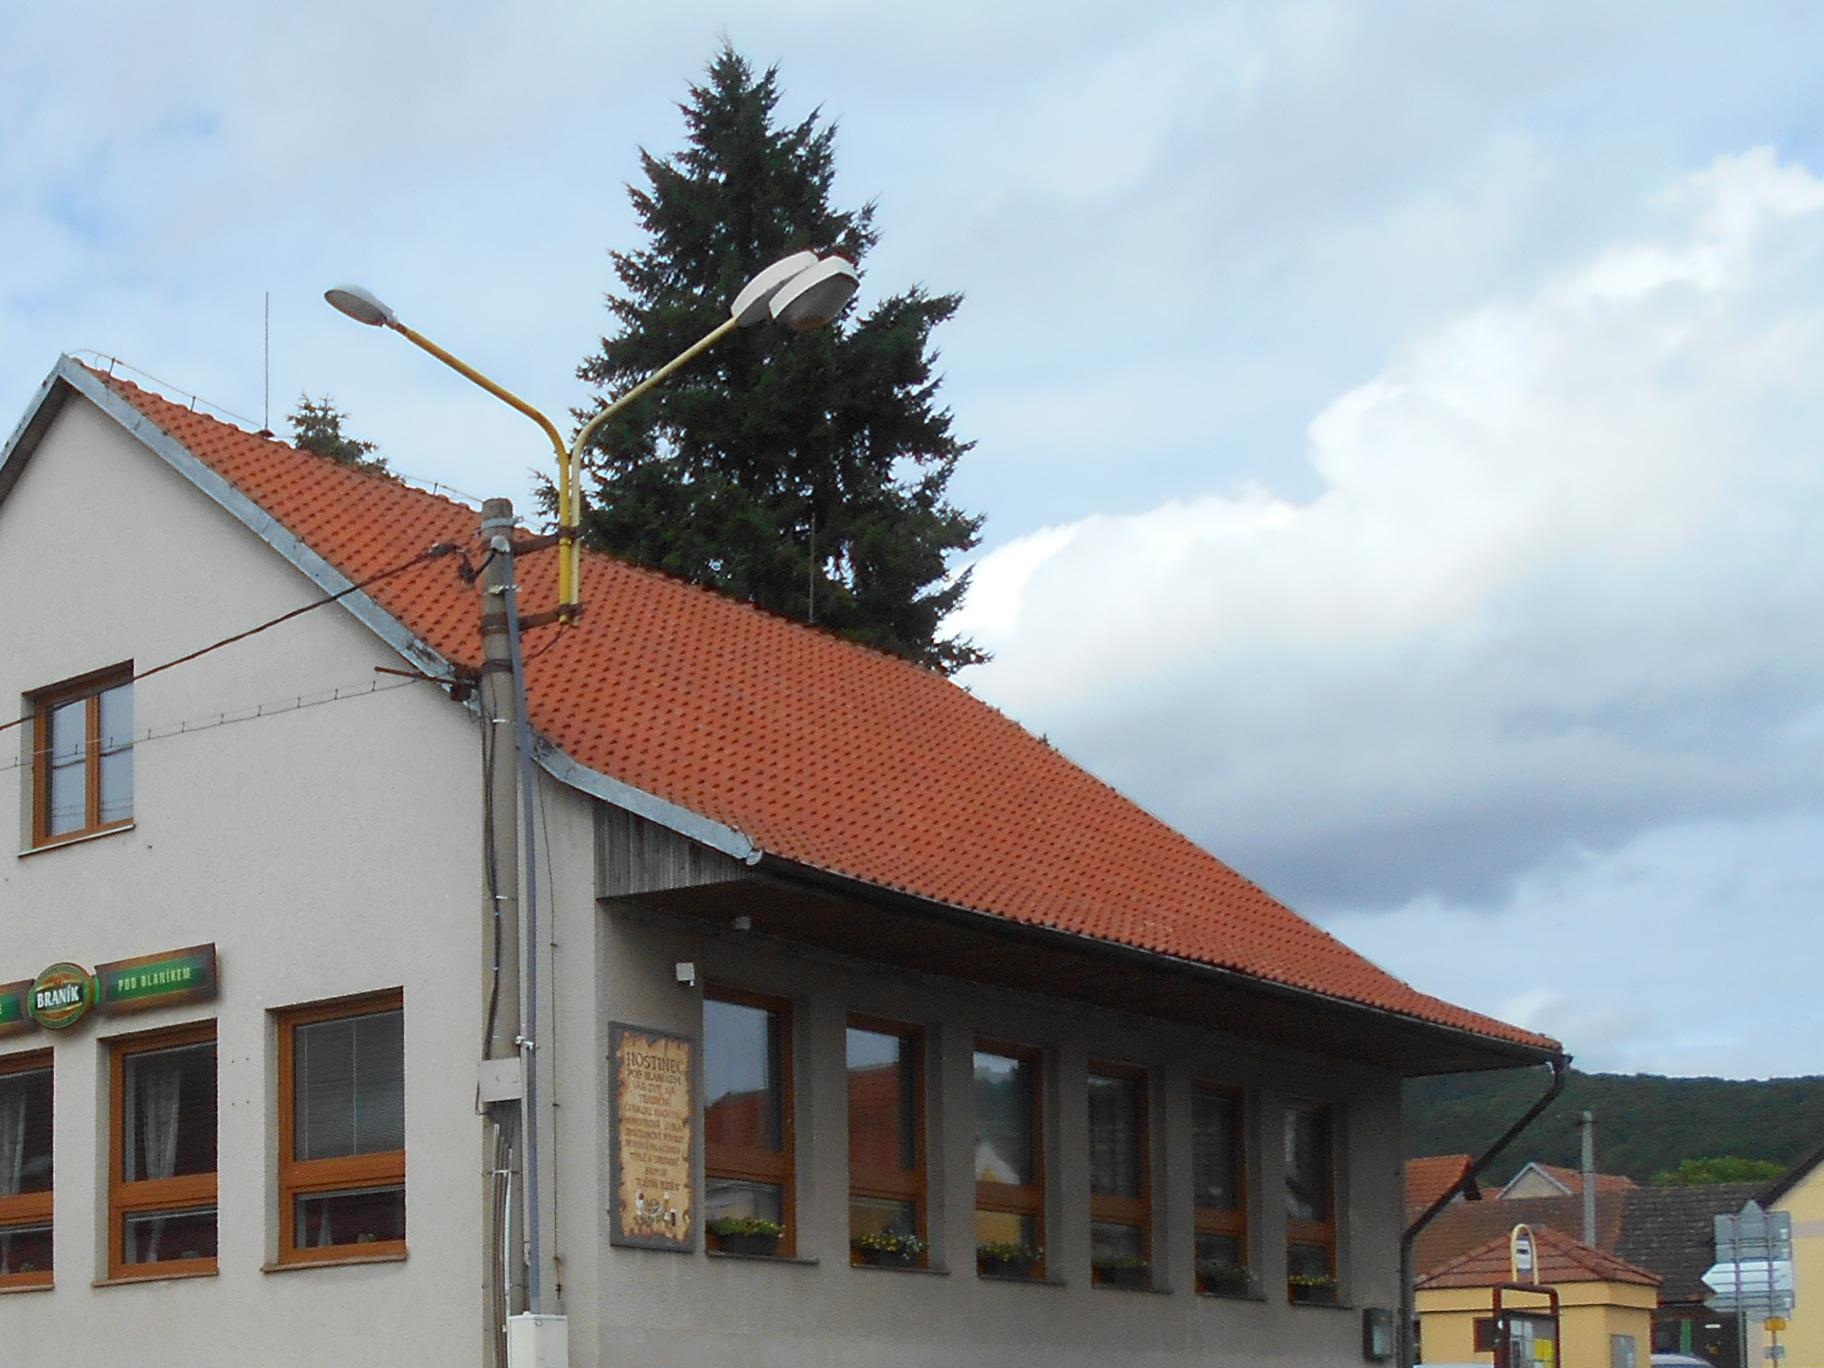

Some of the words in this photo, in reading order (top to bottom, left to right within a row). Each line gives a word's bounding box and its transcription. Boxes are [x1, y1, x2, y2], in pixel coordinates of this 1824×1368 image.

[118, 976, 137, 992] POD
[36, 984, 80, 1009] BRANÍK
[626, 1051, 684, 1074] HOSTINEC
